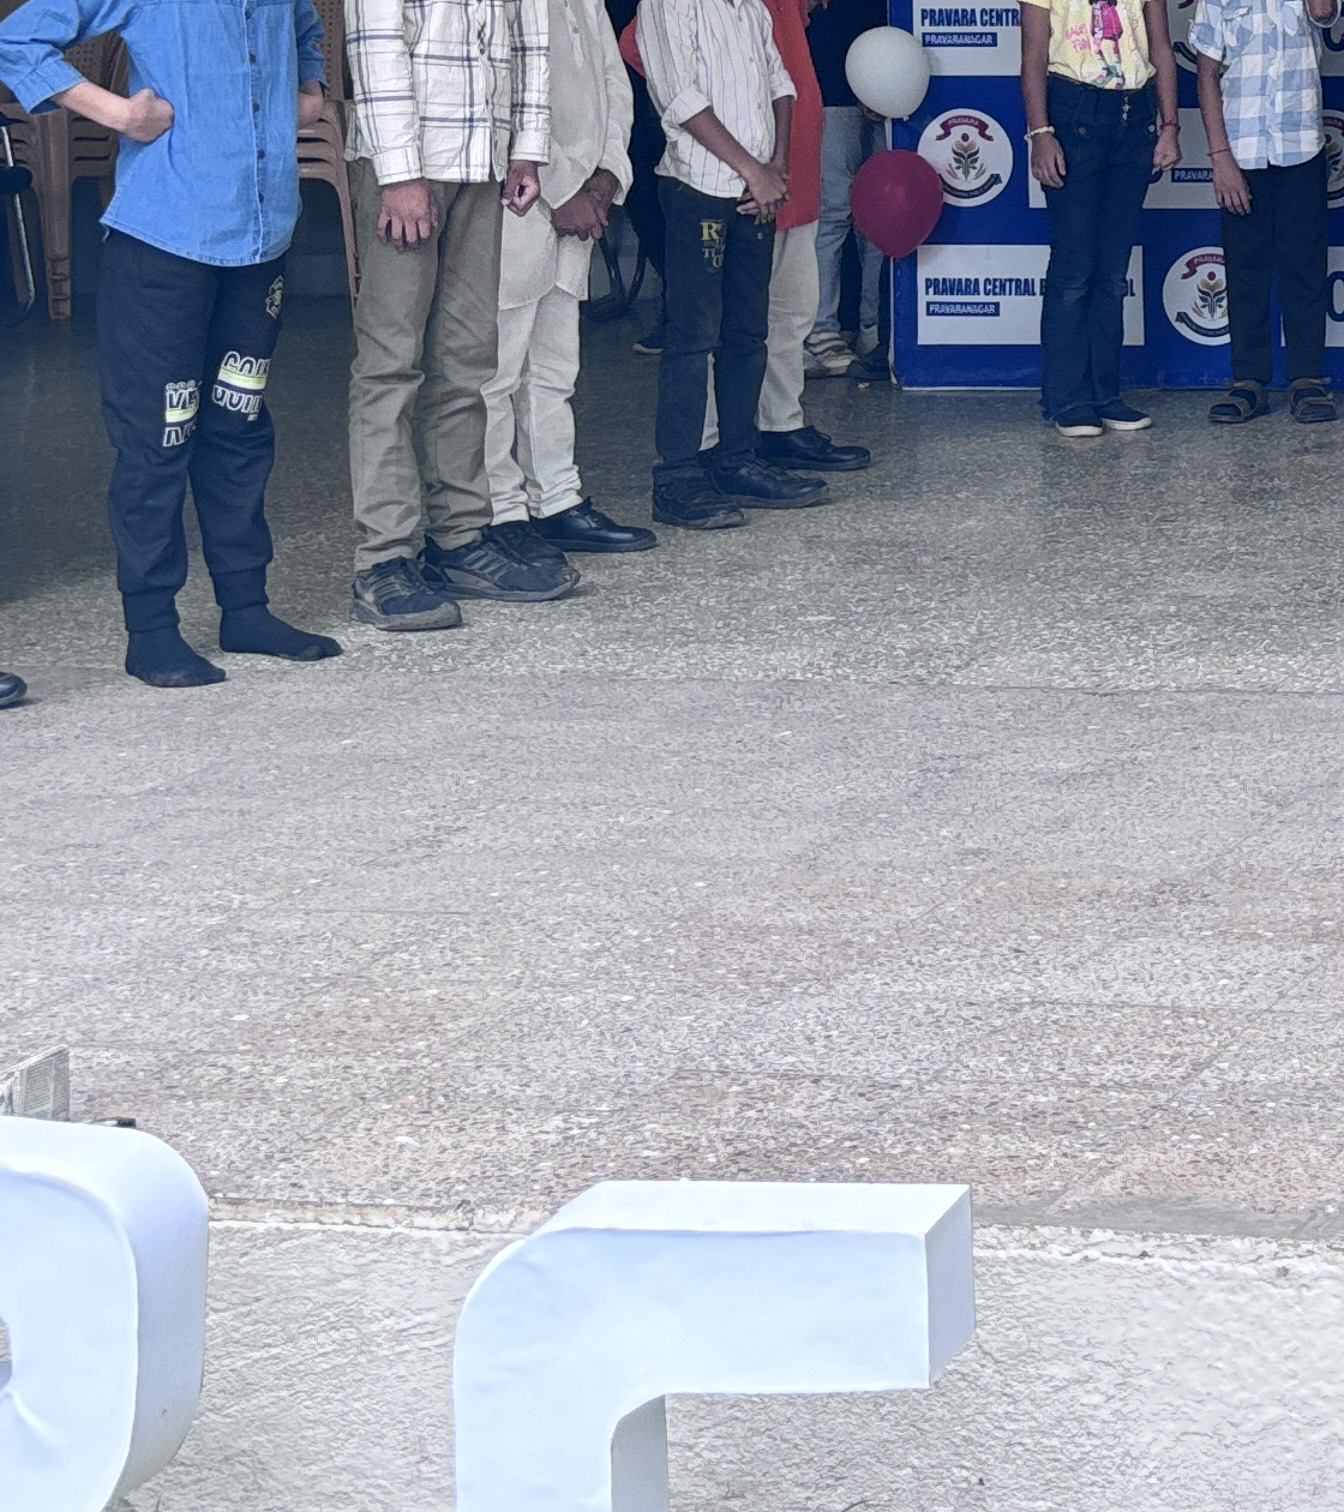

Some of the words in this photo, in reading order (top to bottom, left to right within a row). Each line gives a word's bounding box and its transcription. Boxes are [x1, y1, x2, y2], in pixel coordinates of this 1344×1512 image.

[921, 8, 977, 27] PRAVARA
[980, 8, 1021, 27] CENTR
[1174, 170, 1213, 181] PRAVARA
[925, 278, 981, 297] PRAVARA
[984, 278, 1037, 297] CENTRAL
